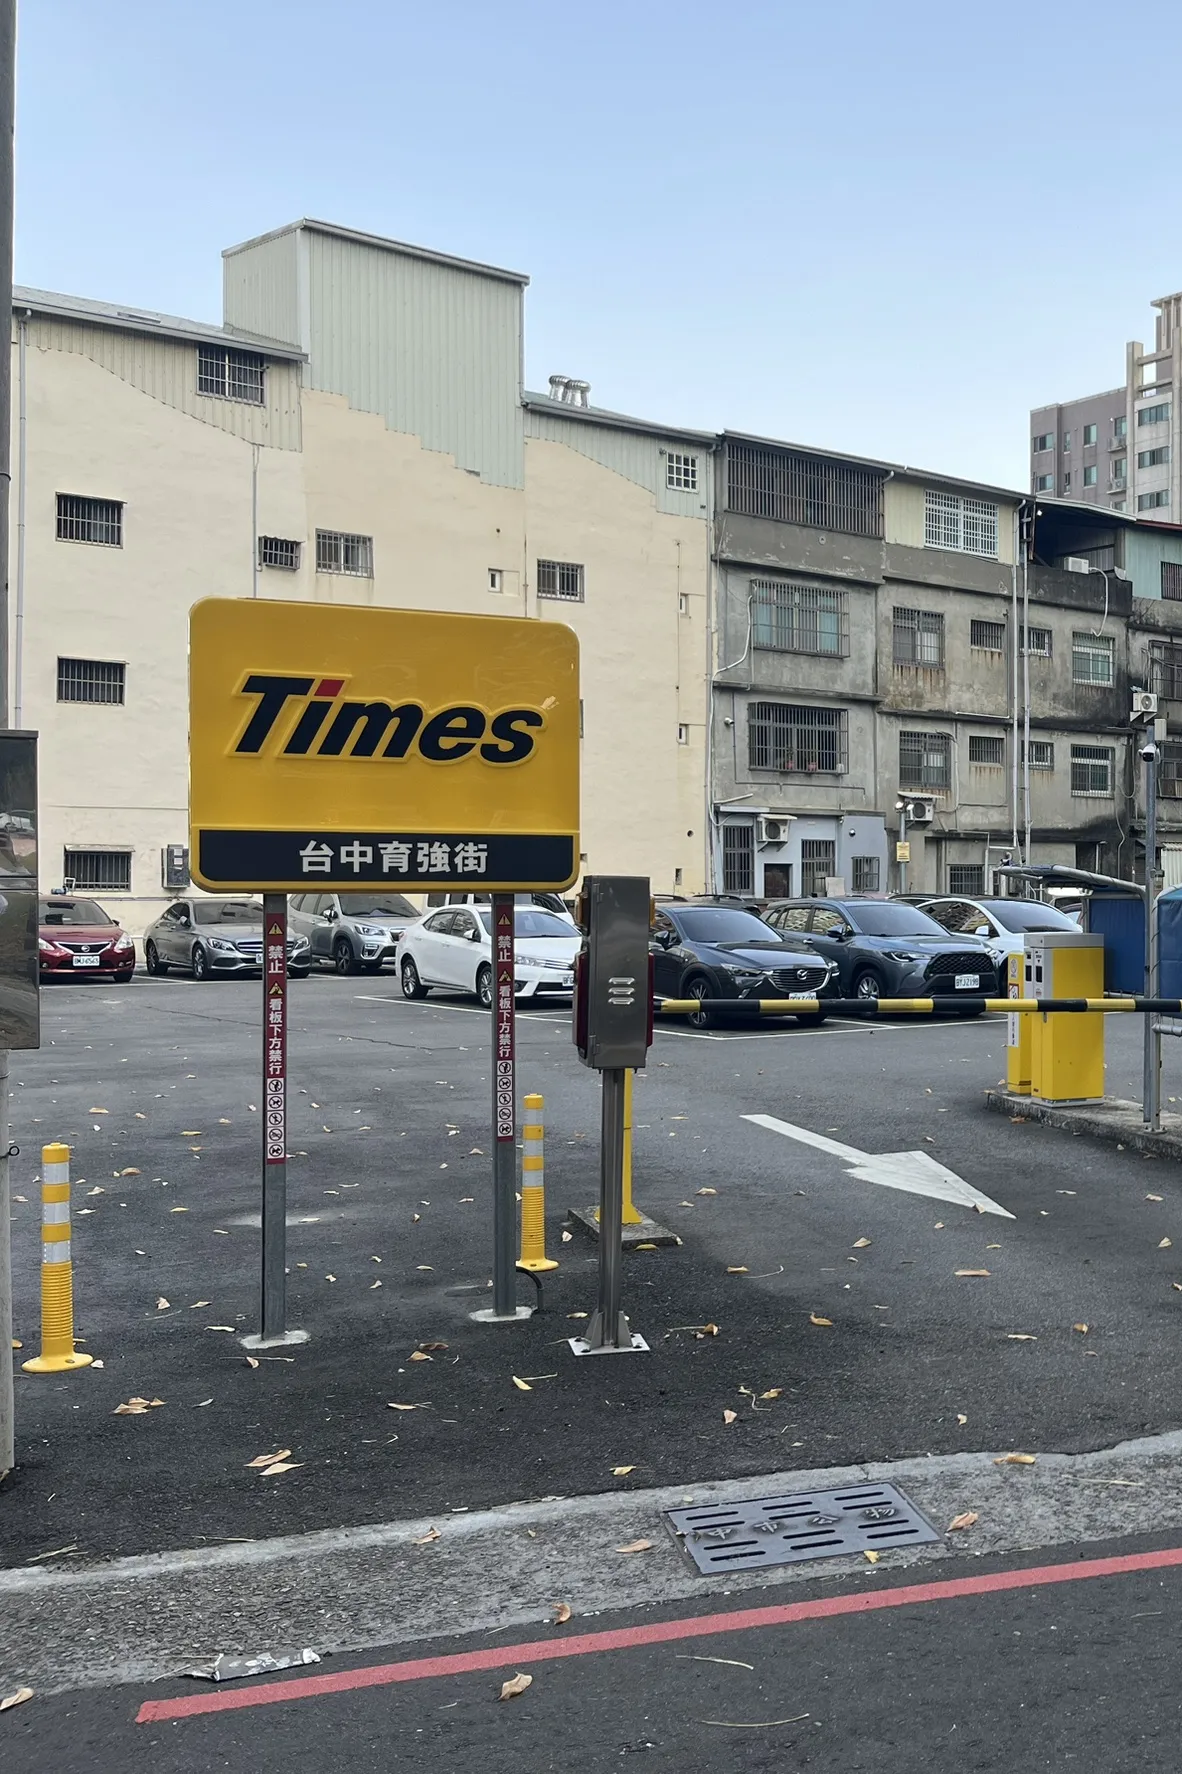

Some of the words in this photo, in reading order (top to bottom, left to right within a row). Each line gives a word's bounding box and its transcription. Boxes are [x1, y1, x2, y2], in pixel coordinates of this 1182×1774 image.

[236, 676, 543, 763] Times
[299, 841, 488, 874] 台中育強街
[268, 945, 284, 974] 禁止
[498, 935, 512, 963] 禁止
[268, 998, 283, 1076] 看板下方禁行
[499, 985, 512, 1058] 看板下方禁行
[707, 1507, 898, 1540] 中市公物
